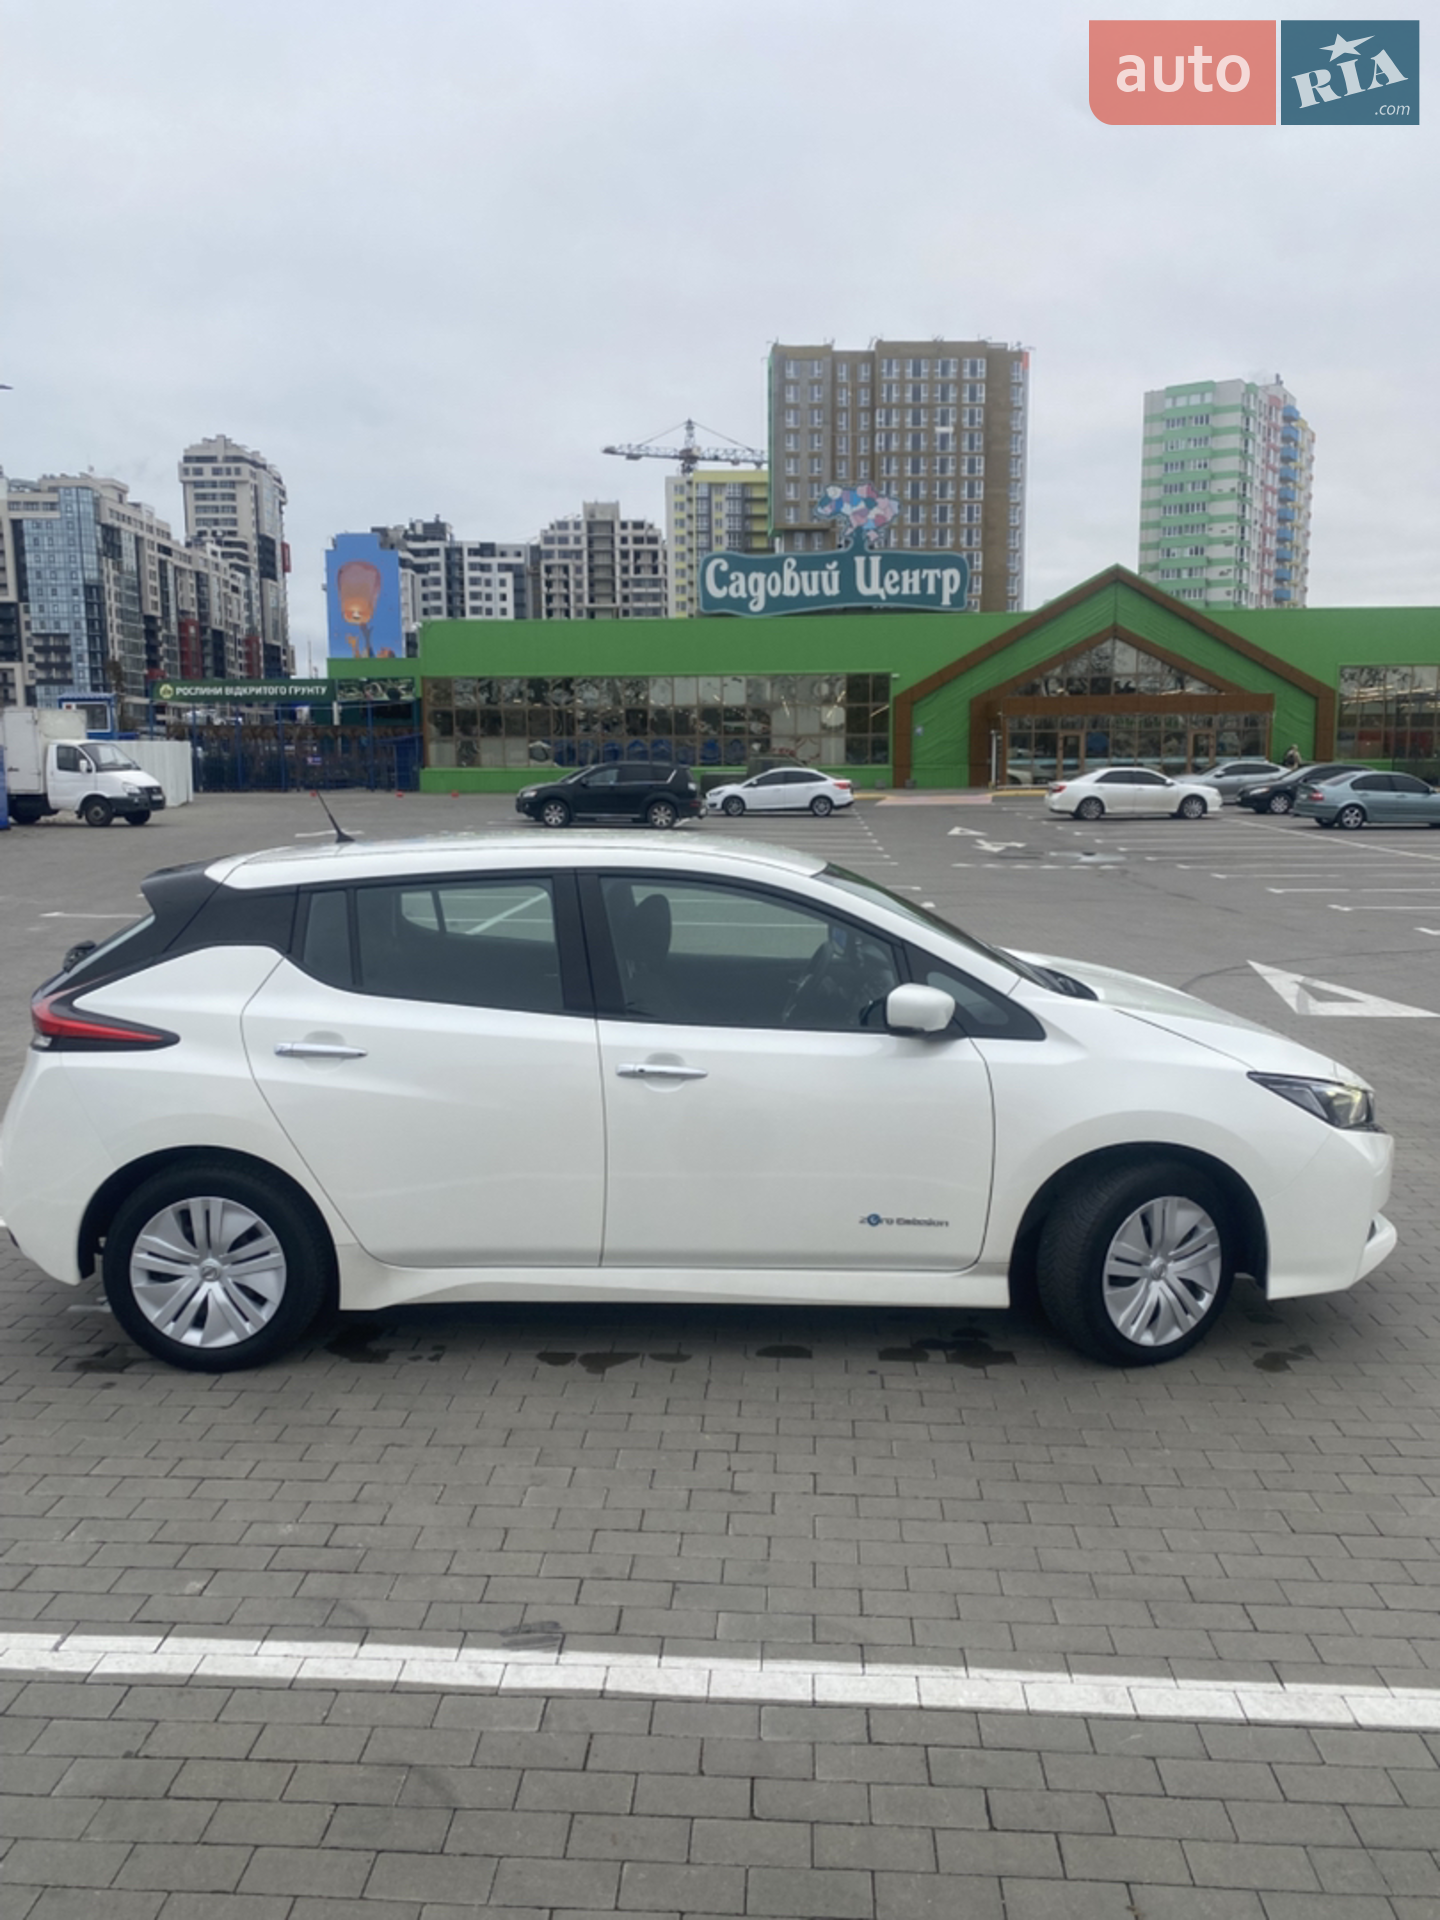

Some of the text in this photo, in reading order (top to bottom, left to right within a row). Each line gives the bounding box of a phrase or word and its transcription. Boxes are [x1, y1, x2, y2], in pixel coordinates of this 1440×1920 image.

[704, 555, 961, 612] Садовий Центр
[175, 686, 223, 696] РОСЛИНИ
[224, 685, 287, 697] ВІДКРИТОГО
